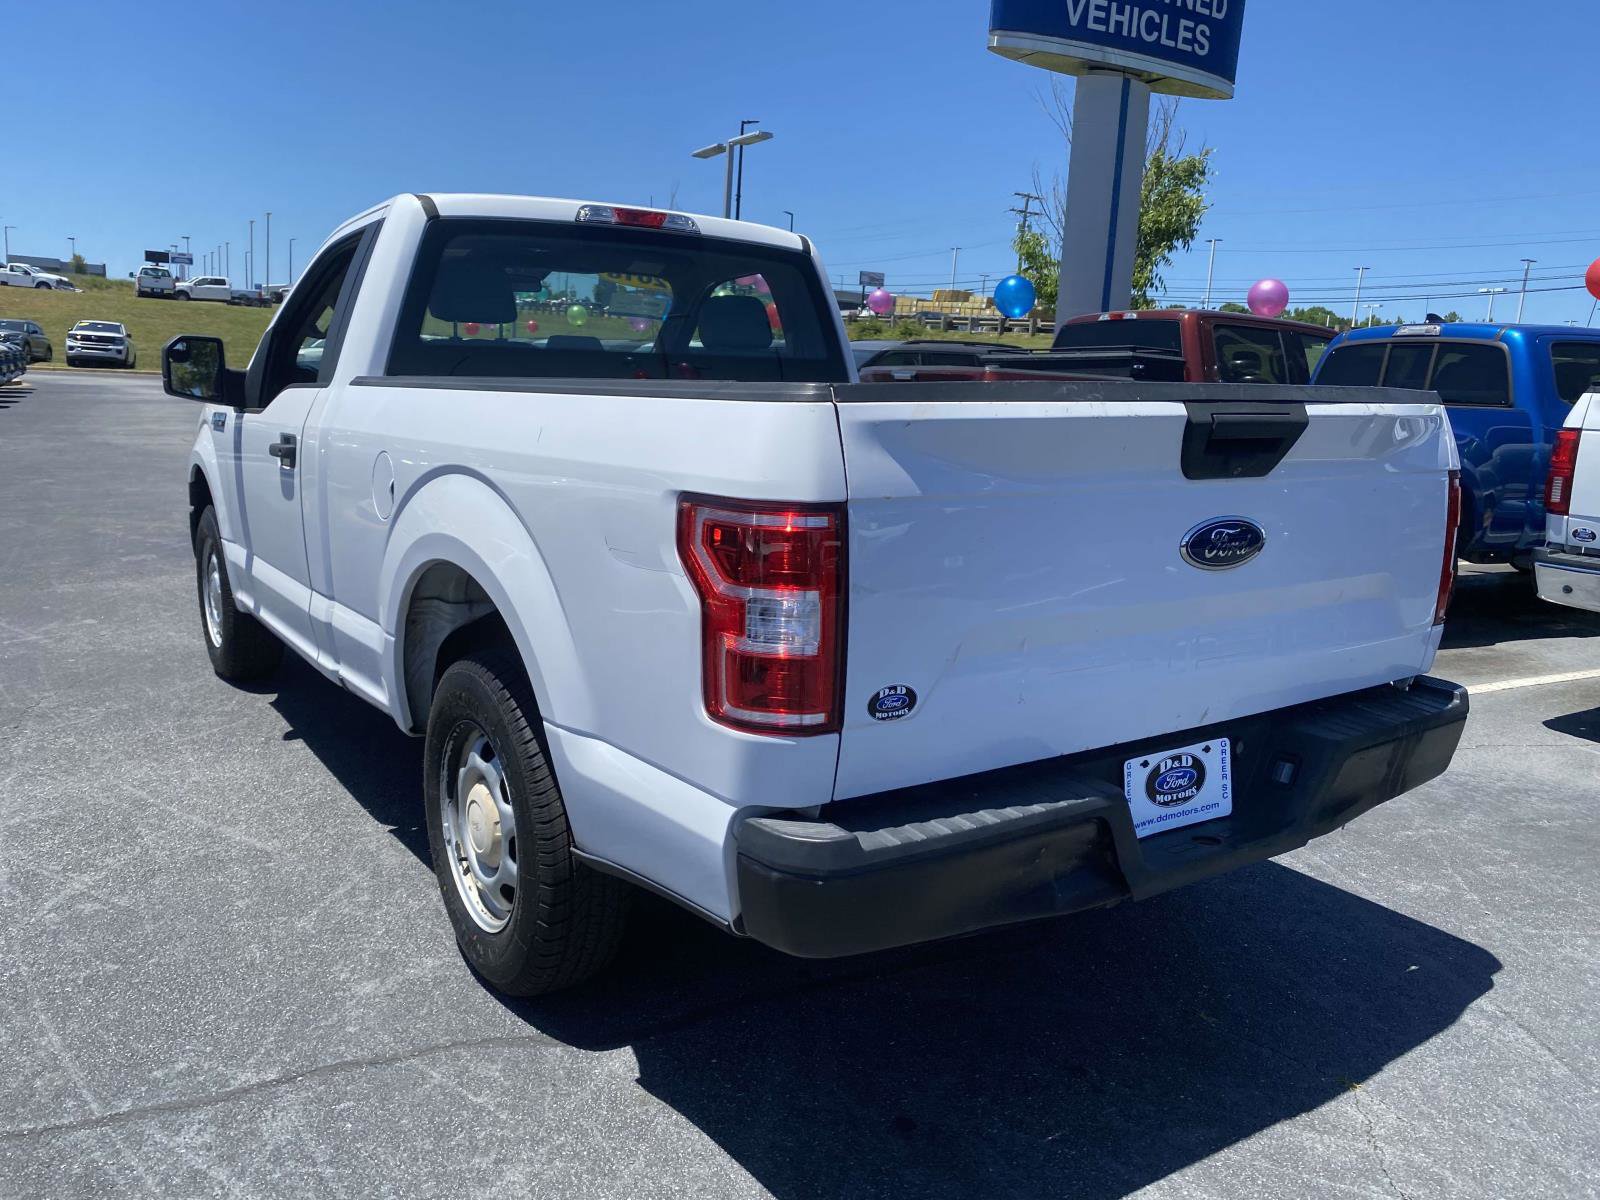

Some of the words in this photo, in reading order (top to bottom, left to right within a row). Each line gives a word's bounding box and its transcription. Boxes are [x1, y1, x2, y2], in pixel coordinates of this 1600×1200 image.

[1066, 0, 1211, 56] VEHICLES
[1204, 527, 1251, 559] Ford
[879, 686, 907, 698] D&D
[882, 697, 903, 709] Ford
[875, 707, 909, 719] MOTORS
[1159, 755, 1193, 774] D&D
[1220, 740, 1228, 780] GREER
[1163, 772, 1190, 789] Ford
[1155, 785, 1197, 804] MOTORS
[1222, 784, 1229, 799] SC
[1134, 802, 1220, 829] www.ddmotors.com
